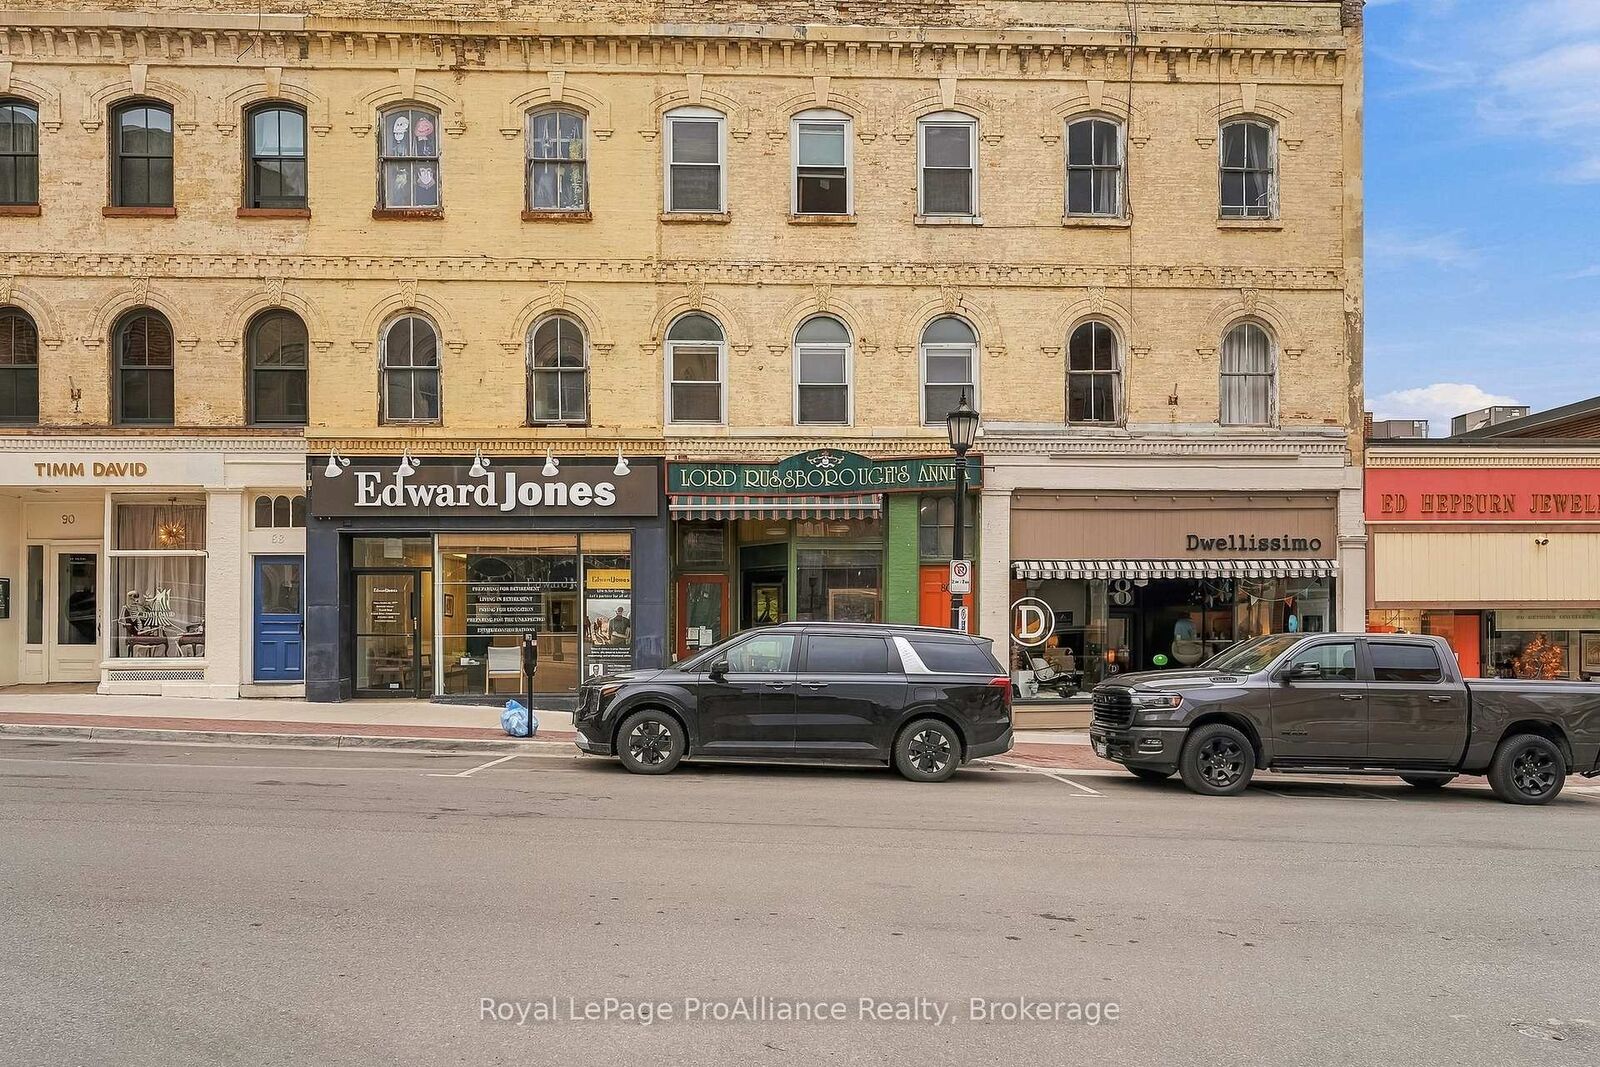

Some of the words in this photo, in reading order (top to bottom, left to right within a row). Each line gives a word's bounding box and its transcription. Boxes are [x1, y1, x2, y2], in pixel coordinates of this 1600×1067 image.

[34, 462, 85, 477] TIMM
[92, 462, 148, 477] DAVID
[680, 468, 737, 488] LORD
[744, 464, 911, 490] RUSSBOROUGH'S
[1381, 493, 1408, 514] ED
[1420, 493, 1517, 514] HEPBURN
[61, 513, 76, 525] 90
[1186, 534, 1322, 552] Dwellissimo
[1018, 605, 1045, 639] D
